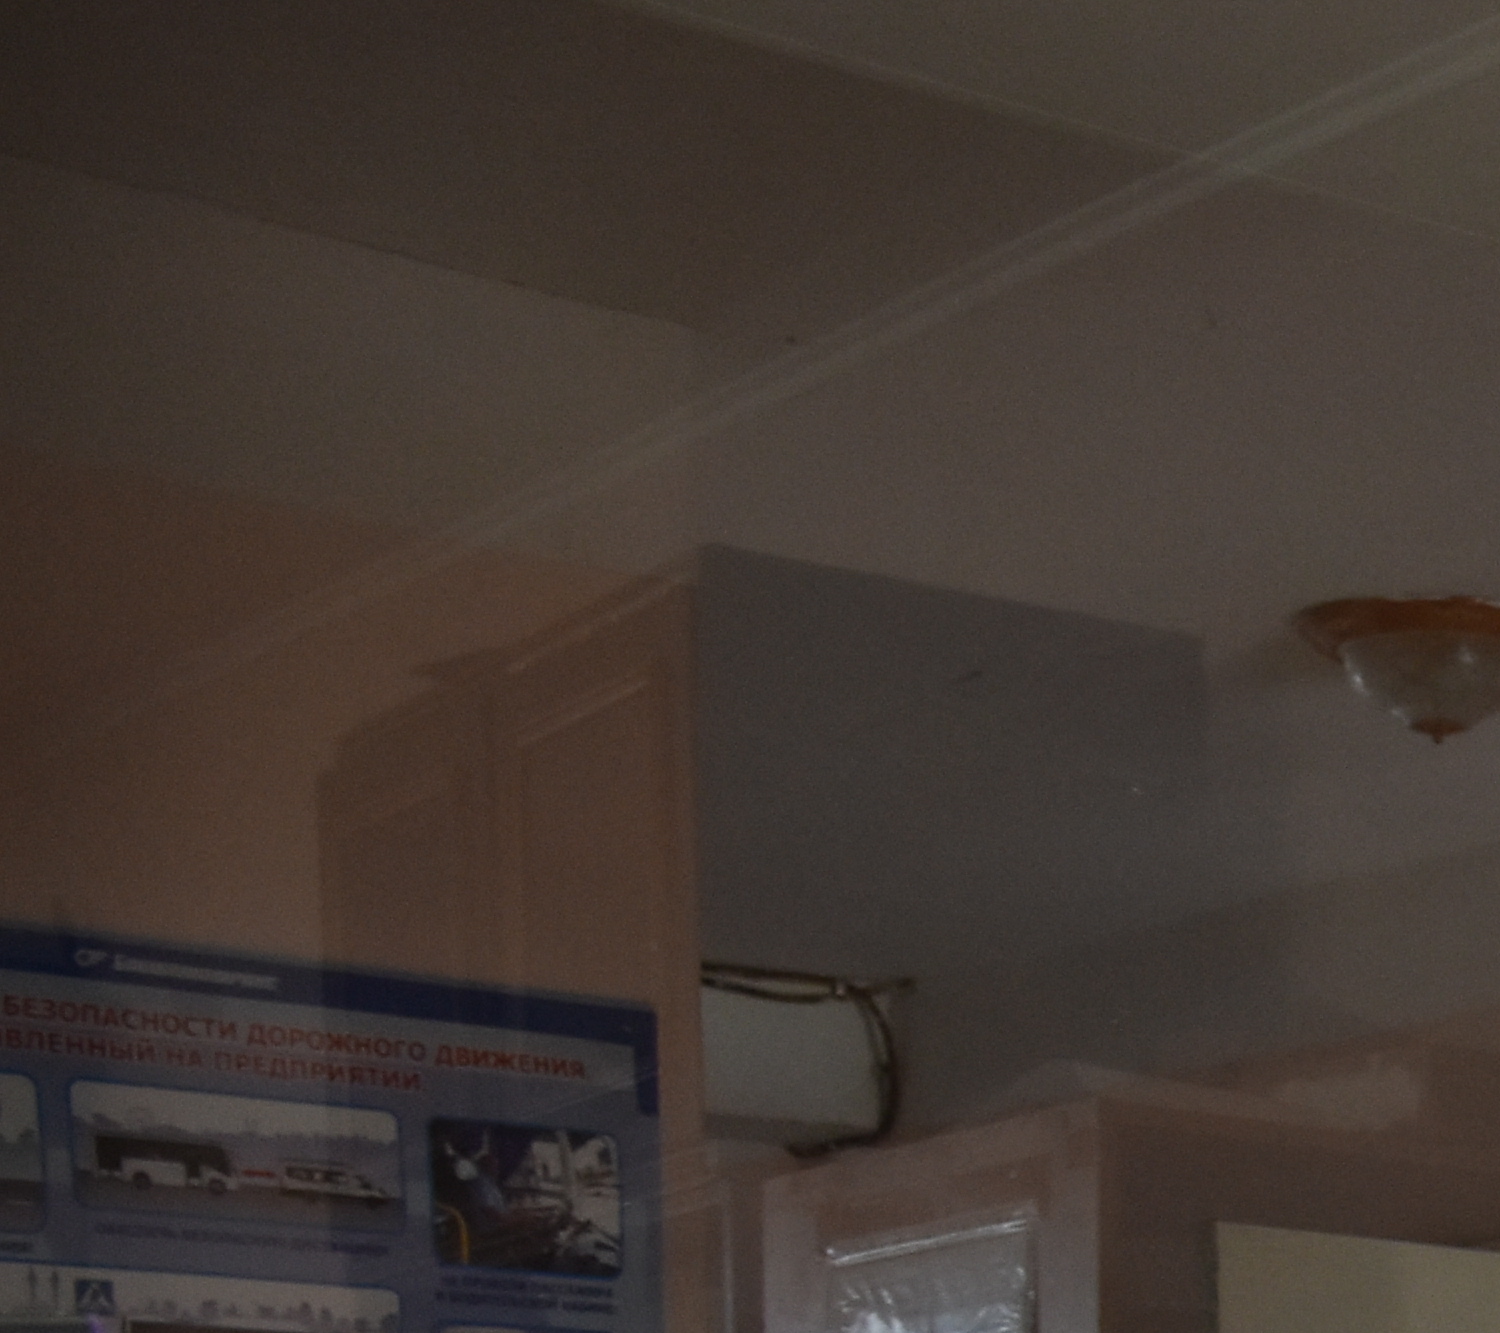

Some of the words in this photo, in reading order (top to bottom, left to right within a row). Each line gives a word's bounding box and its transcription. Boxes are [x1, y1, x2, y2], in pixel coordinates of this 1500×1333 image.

[0, 1027, 157, 1064] ВЛЕННЫЙ
[165, 1047, 203, 1068] НА
[4, 994, 237, 1041] БЕЗОПАСНОСТИ
[247, 1023, 427, 1061] ДОРОЖНОГО
[435, 1044, 586, 1078] ДВИЖЕНИЯ
